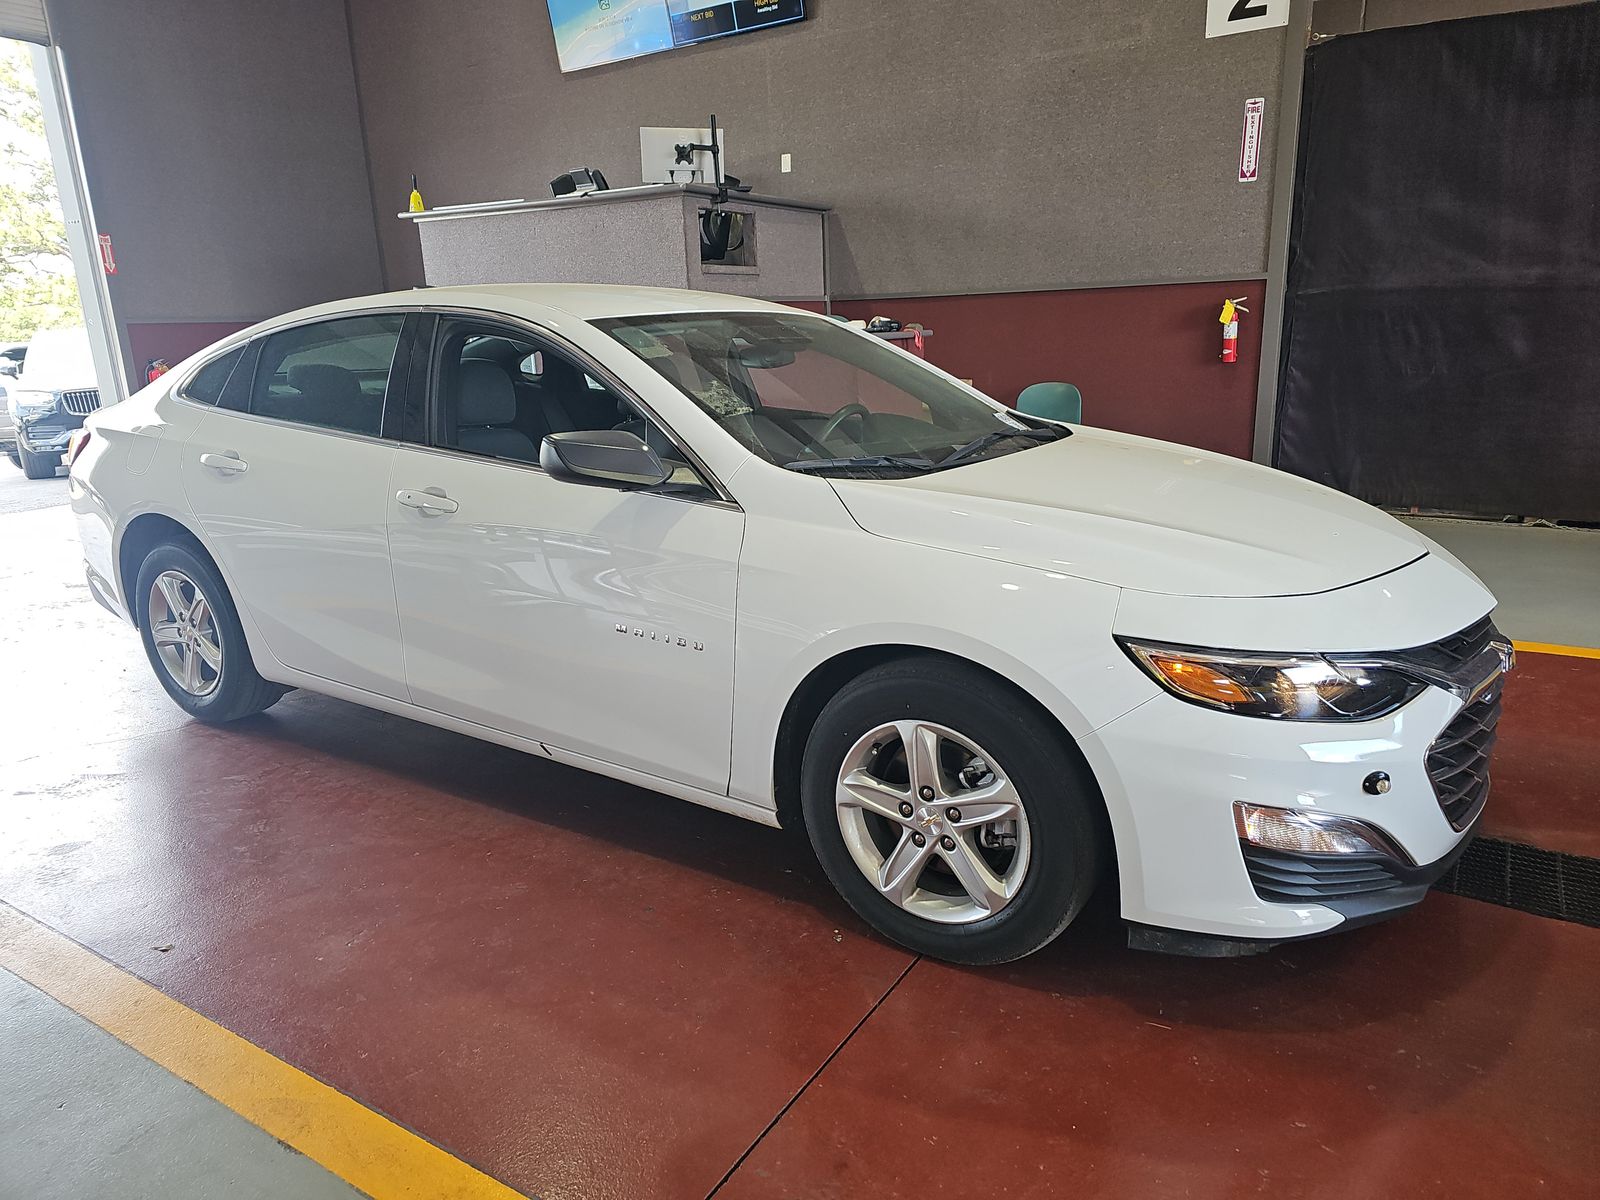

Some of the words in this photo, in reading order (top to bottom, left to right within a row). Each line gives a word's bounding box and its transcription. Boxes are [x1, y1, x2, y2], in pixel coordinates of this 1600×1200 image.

[691, 12, 704, 21] NEXT
[705, 10, 714, 18] BID
[1246, 115, 1256, 174] EXTINGUISHER
